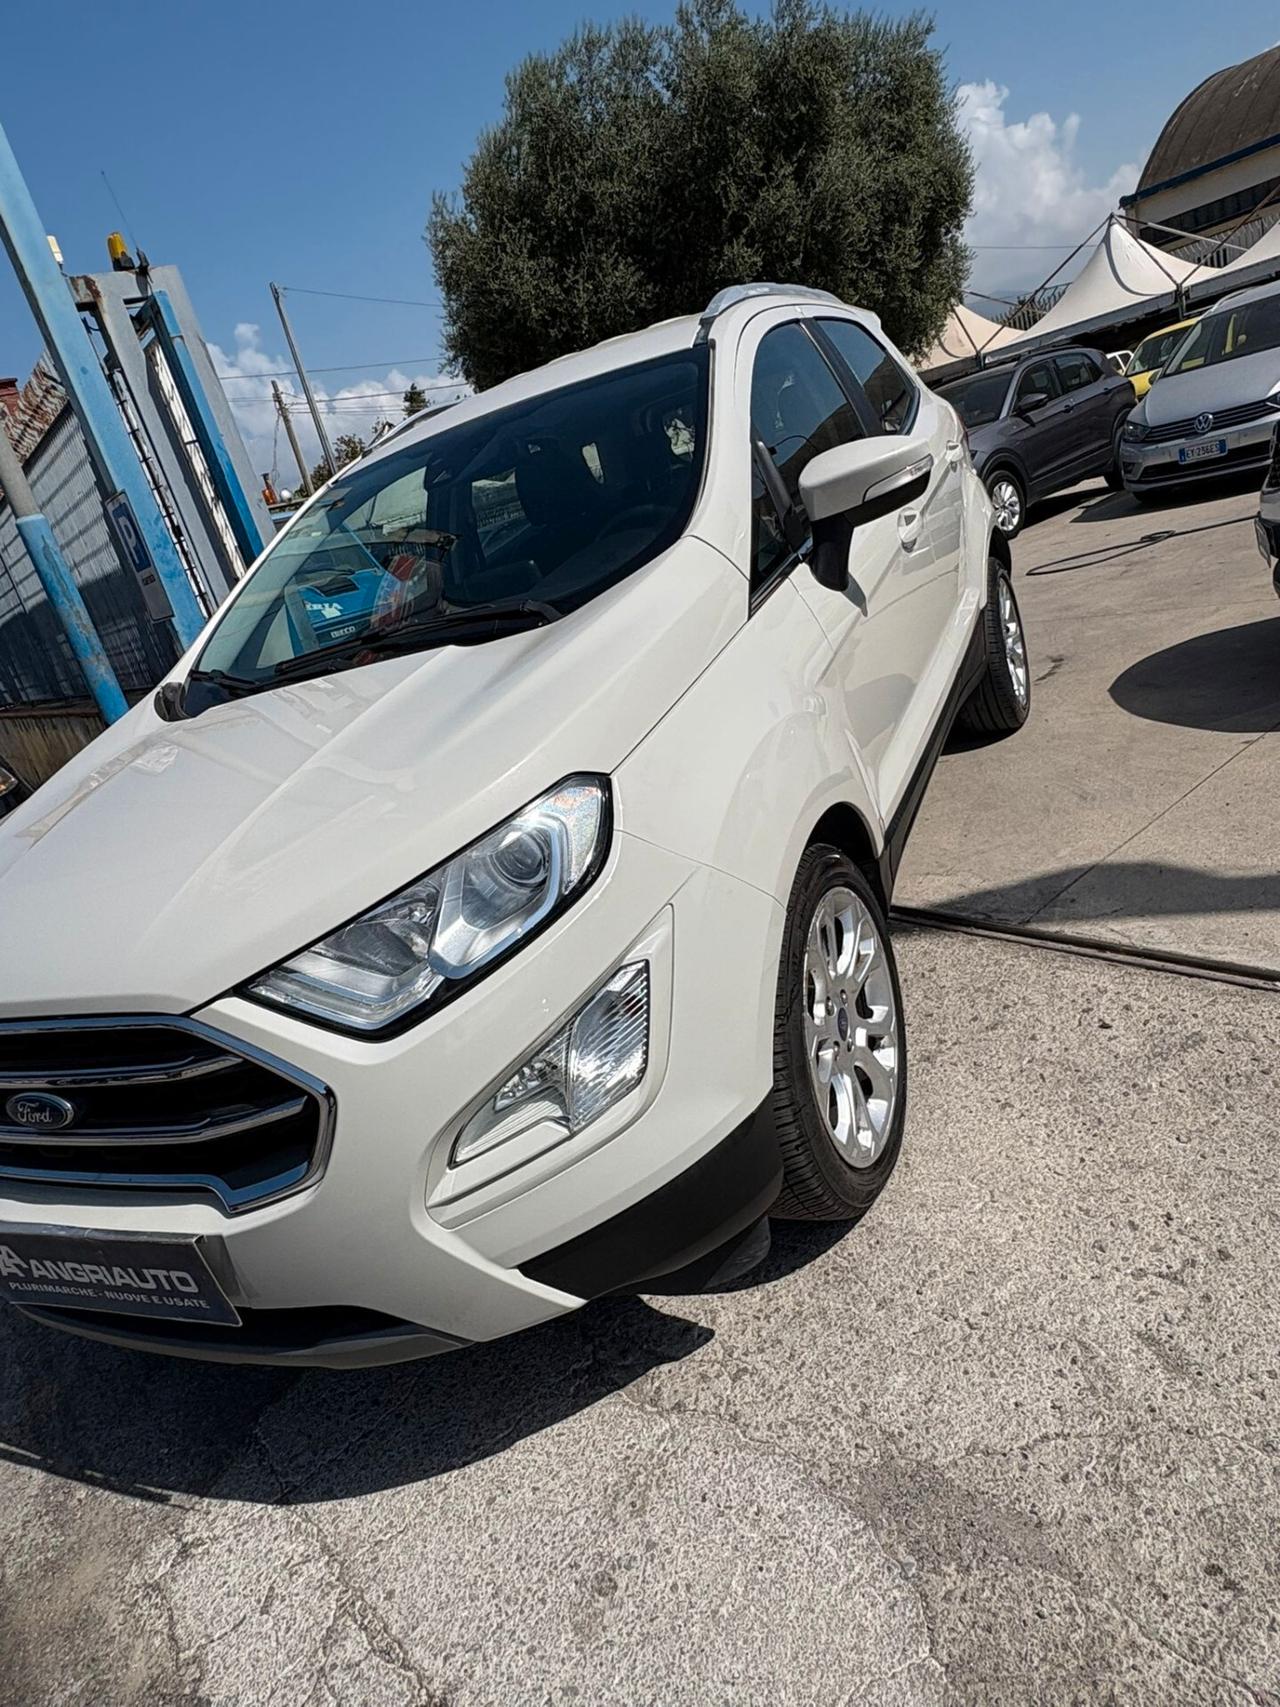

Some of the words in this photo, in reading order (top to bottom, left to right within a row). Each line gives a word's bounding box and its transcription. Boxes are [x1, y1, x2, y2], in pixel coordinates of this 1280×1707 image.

[17, 1101, 53, 1123] Ford
[29, 1259, 199, 1293] ANGRIAUTO
[104, 1290, 151, 1304] NUOVE
[162, 1296, 211, 1309] USATE
